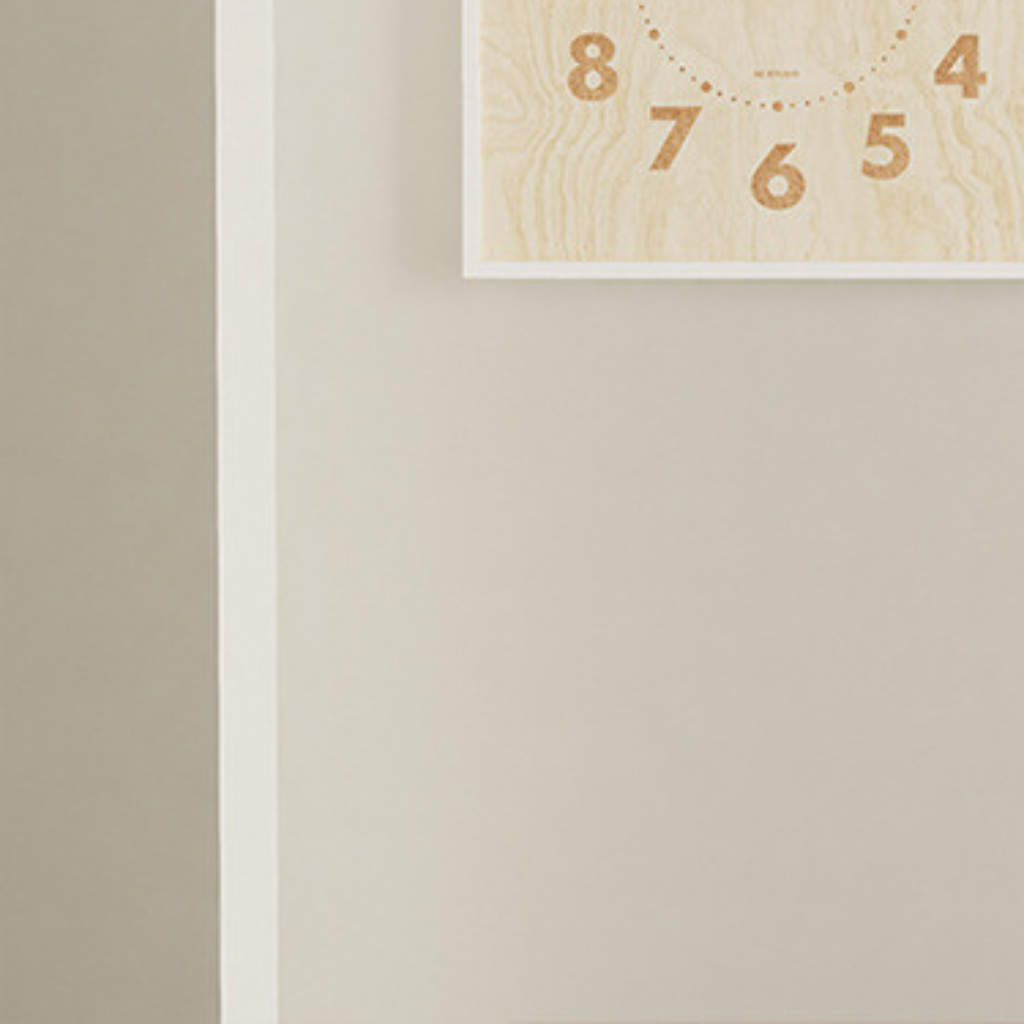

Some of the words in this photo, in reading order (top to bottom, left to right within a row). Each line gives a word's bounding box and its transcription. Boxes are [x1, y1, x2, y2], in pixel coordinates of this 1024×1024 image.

[567, 32, 619, 102] 8
[933, 34, 987, 98] 4
[649, 106, 702, 171] 7
[861, 113, 911, 180] 5
[750, 143, 806, 210] 6
